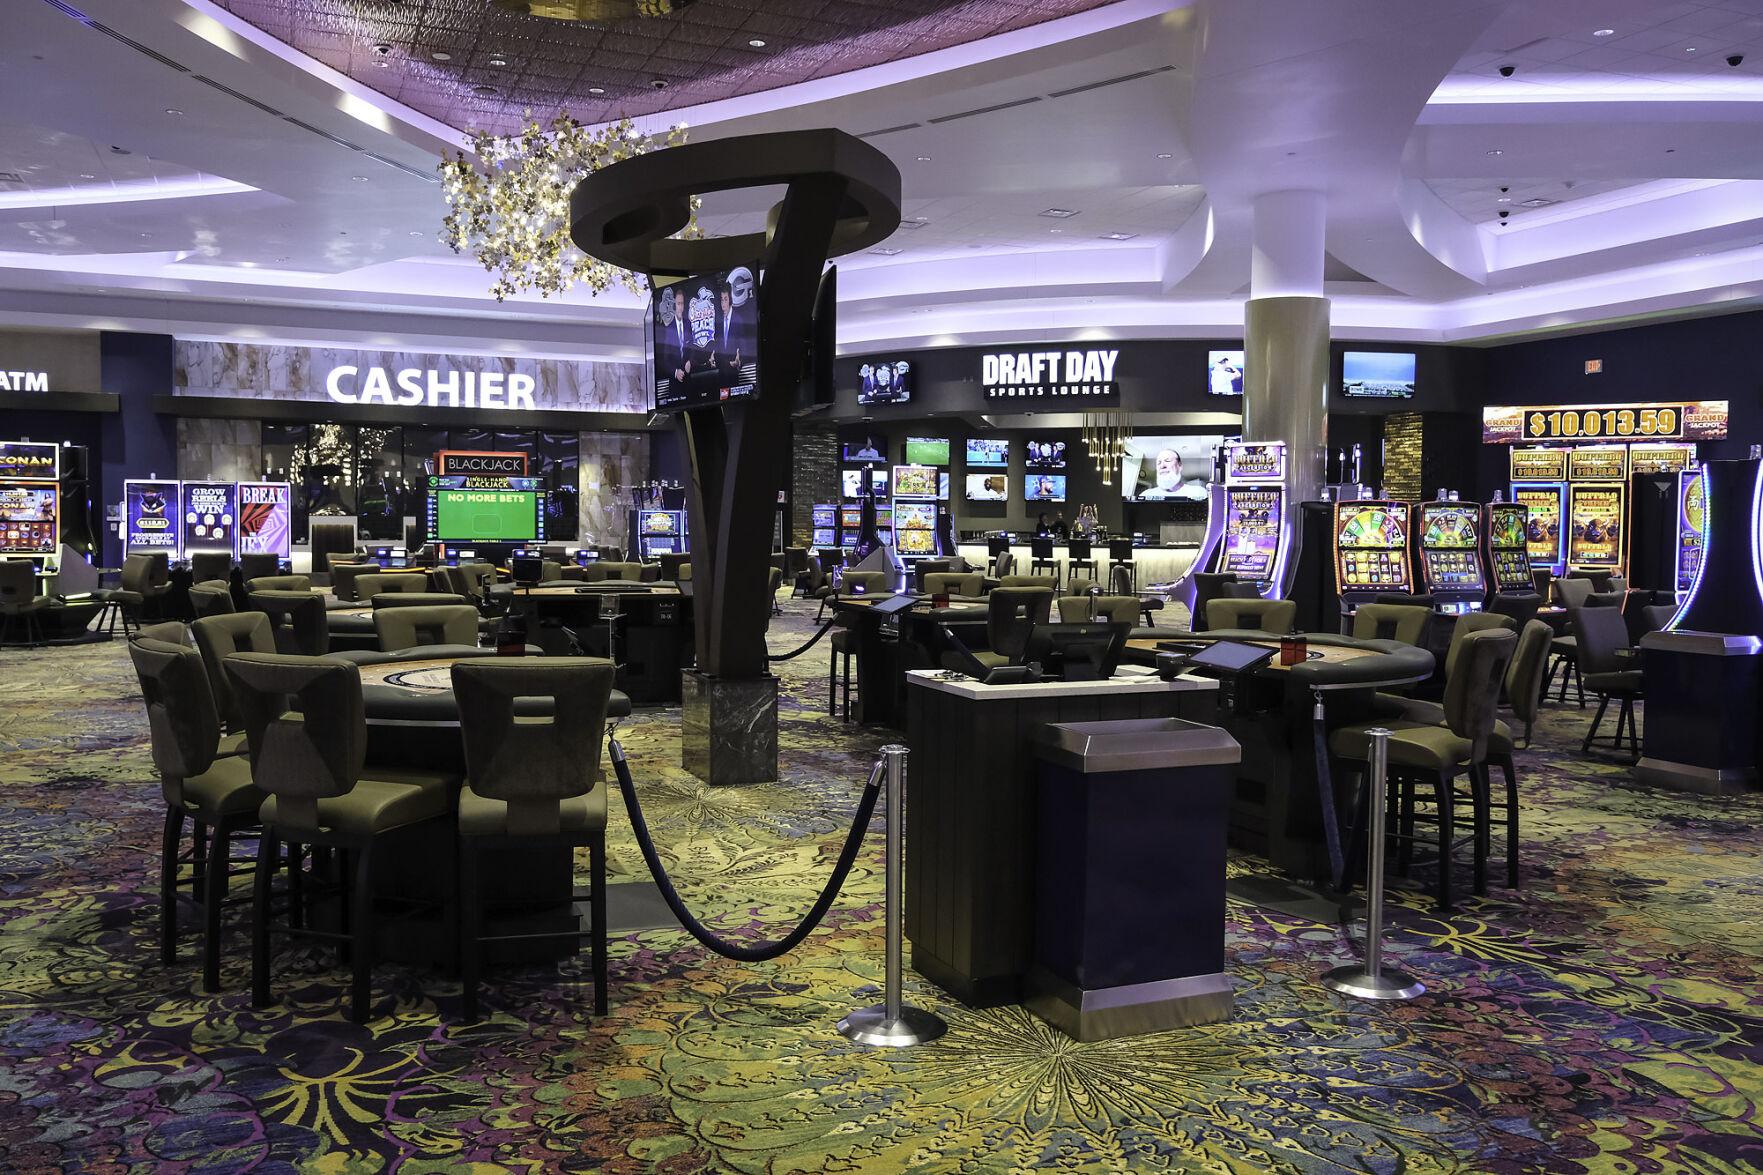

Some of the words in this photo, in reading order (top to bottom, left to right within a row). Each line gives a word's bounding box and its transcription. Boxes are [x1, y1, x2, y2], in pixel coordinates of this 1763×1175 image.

[983, 351, 1061, 386] DRAFT
[1065, 350, 1119, 383] DAY
[0, 370, 48, 392] ATM
[326, 365, 536, 410] CASHIER
[990, 386, 1044, 397] SPORTS
[1051, 385, 1110, 396] LOUNGE
[1485, 418, 1522, 427] GRAND
[1529, 408, 1677, 437] $10,013.59
[1685, 413, 1724, 423] GRAND
[0, 455, 53, 465] CONAN
[448, 458, 521, 471] BLACKJACK
[192, 488, 226, 496] GROW
[242, 487, 285, 504] BREAK
[447, 493, 465, 502] NO
[466, 493, 497, 503] MORE
[499, 494, 525, 503] BETS
[193, 504, 225, 514] WIN
